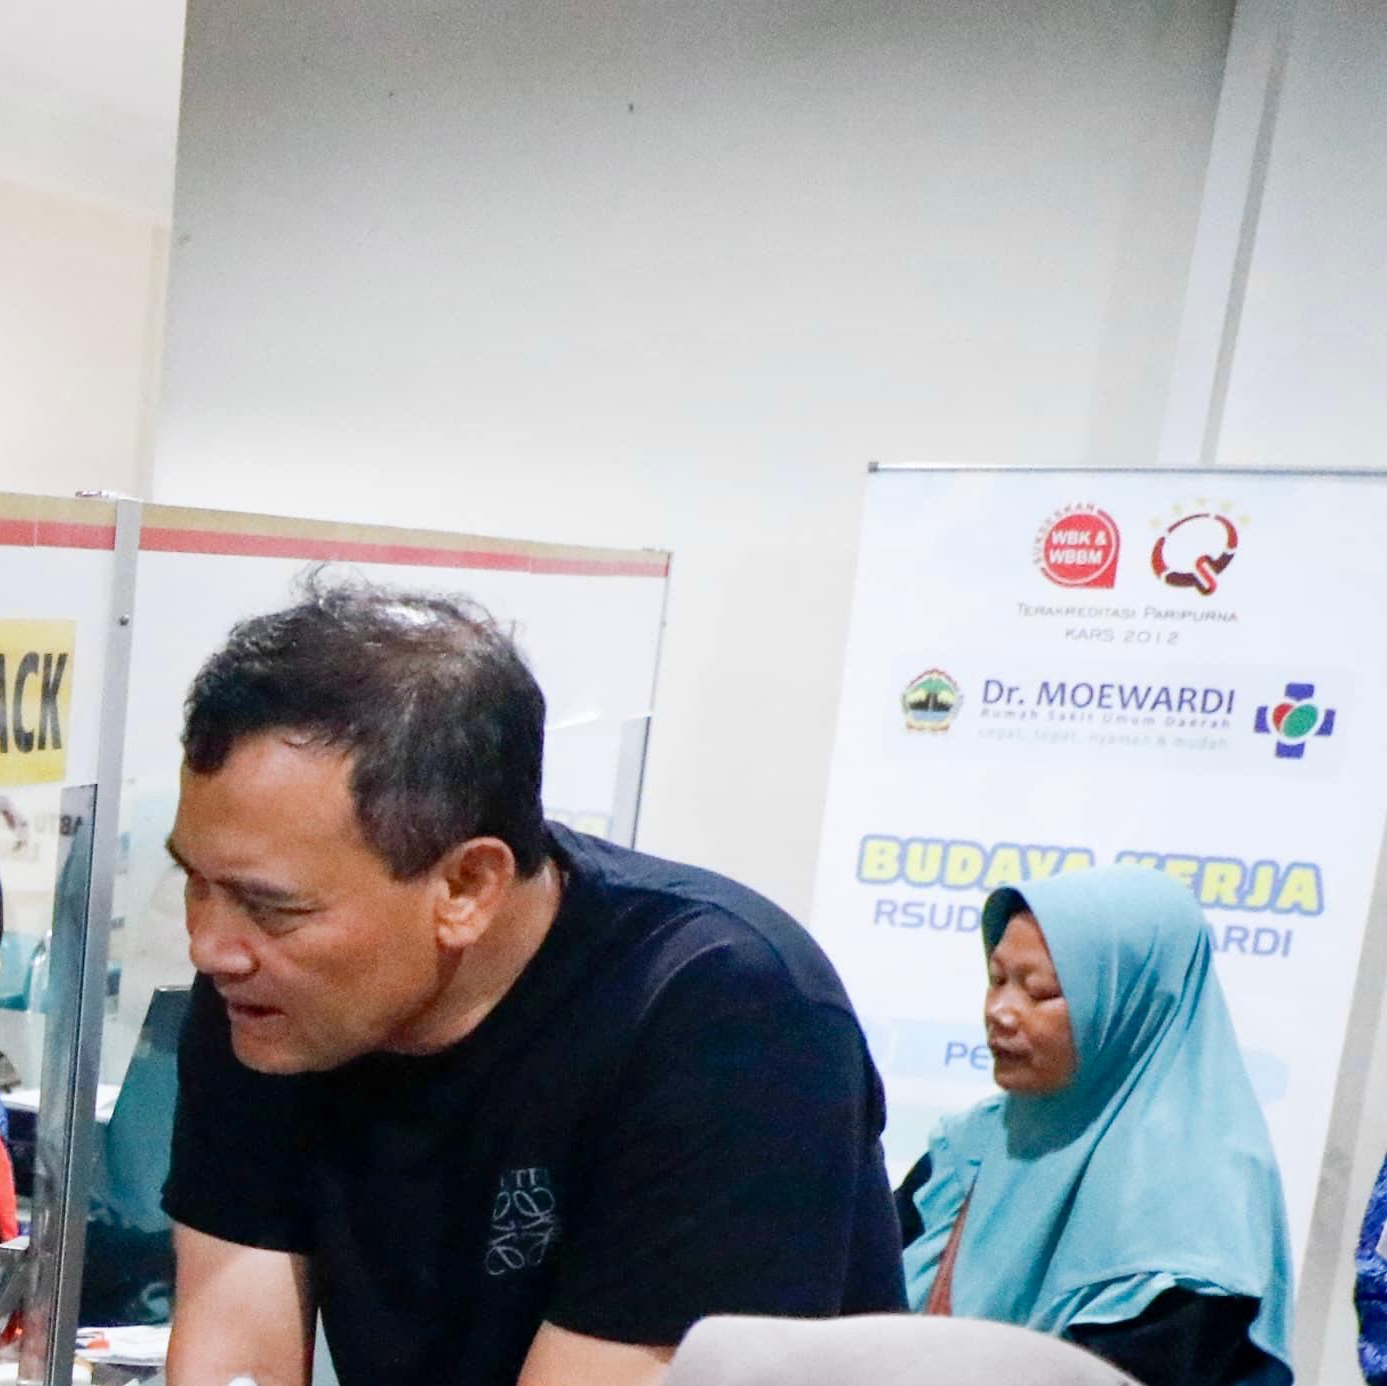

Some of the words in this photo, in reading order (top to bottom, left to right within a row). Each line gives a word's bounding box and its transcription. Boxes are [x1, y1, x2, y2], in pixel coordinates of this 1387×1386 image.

[1051, 530, 1091, 546] WBK
[1065, 628, 1115, 643] KARS
[1123, 630, 1180, 645] 2012
[981, 679, 1025, 705] Dr.
[1035, 681, 1235, 715] MOEWARDI
[1115, 850, 1324, 916] ERJA
[873, 899, 981, 932] RSUD
